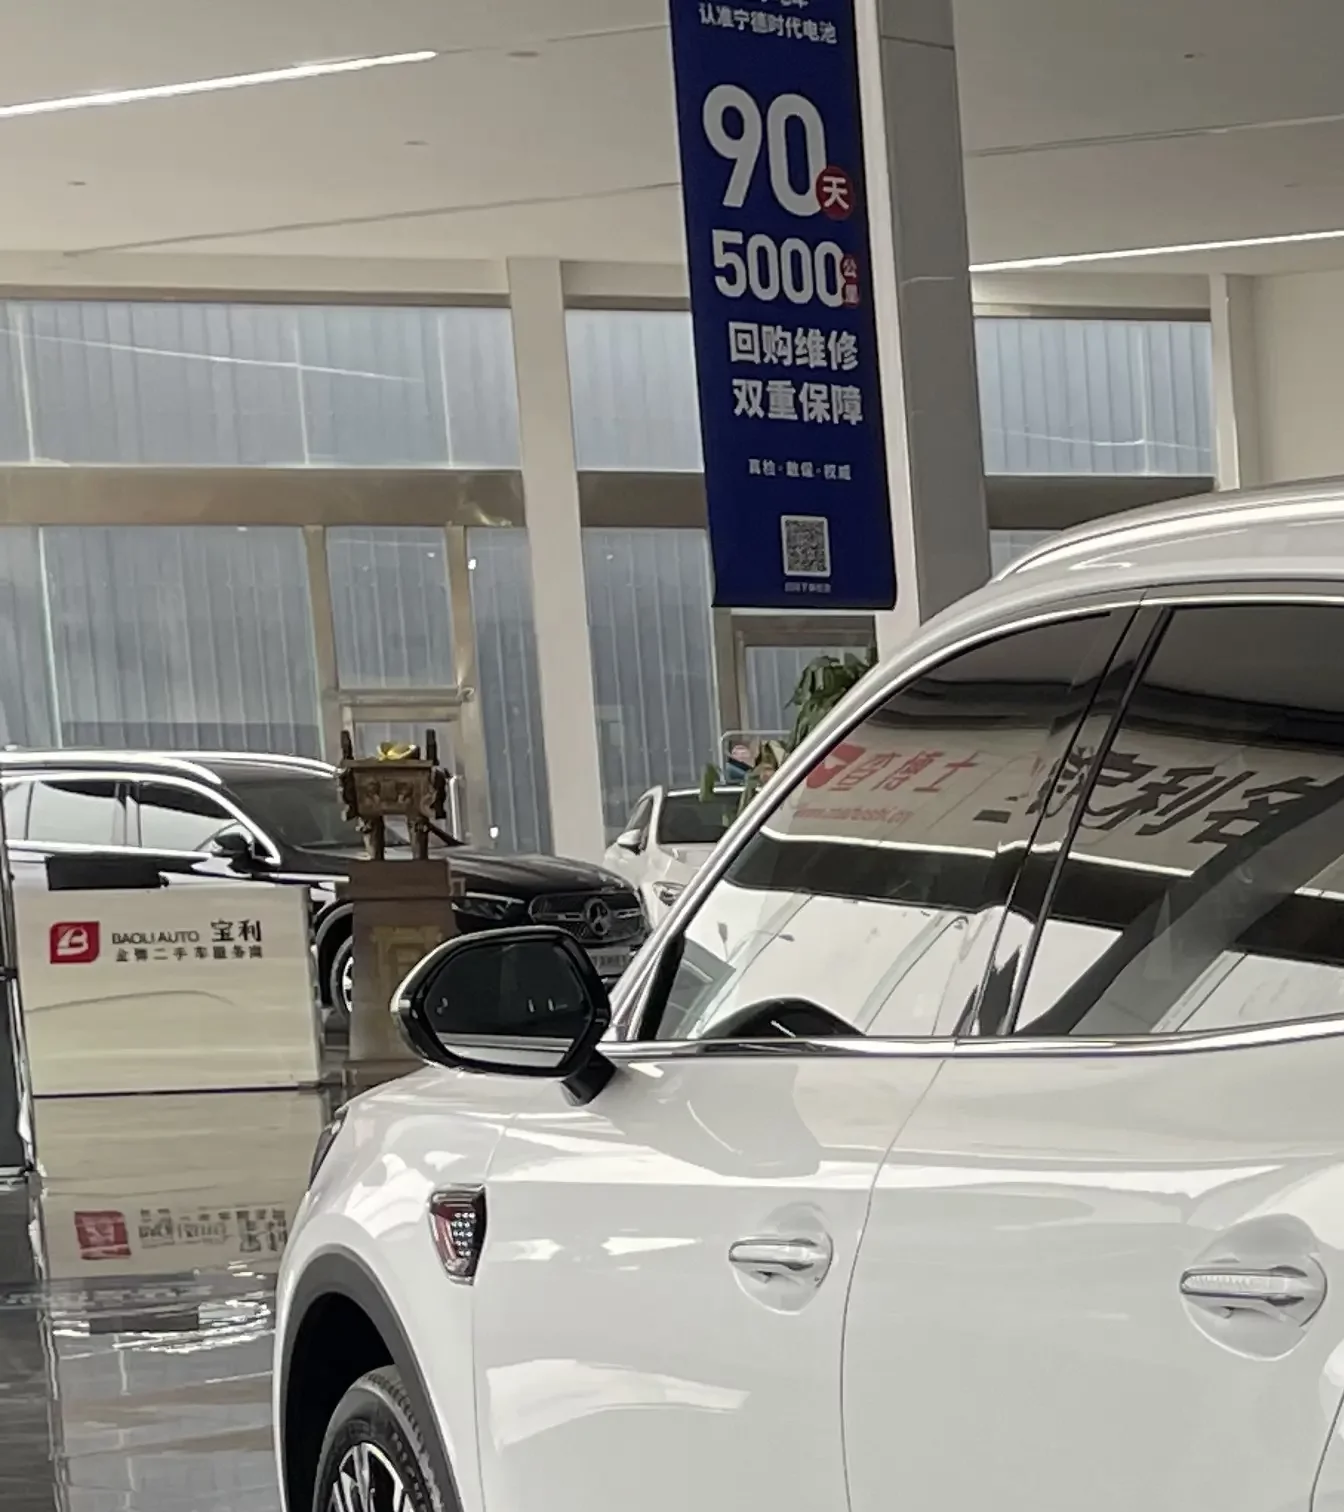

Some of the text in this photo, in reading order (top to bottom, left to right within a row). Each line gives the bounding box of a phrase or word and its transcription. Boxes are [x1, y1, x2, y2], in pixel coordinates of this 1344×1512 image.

[699, 3, 837, 44] 认准宁德时代电池
[728, 321, 859, 371] 回购维修
[733, 379, 863, 426] 双重保障
[112, 919, 262, 945] BAOLI AUTO 宝利
